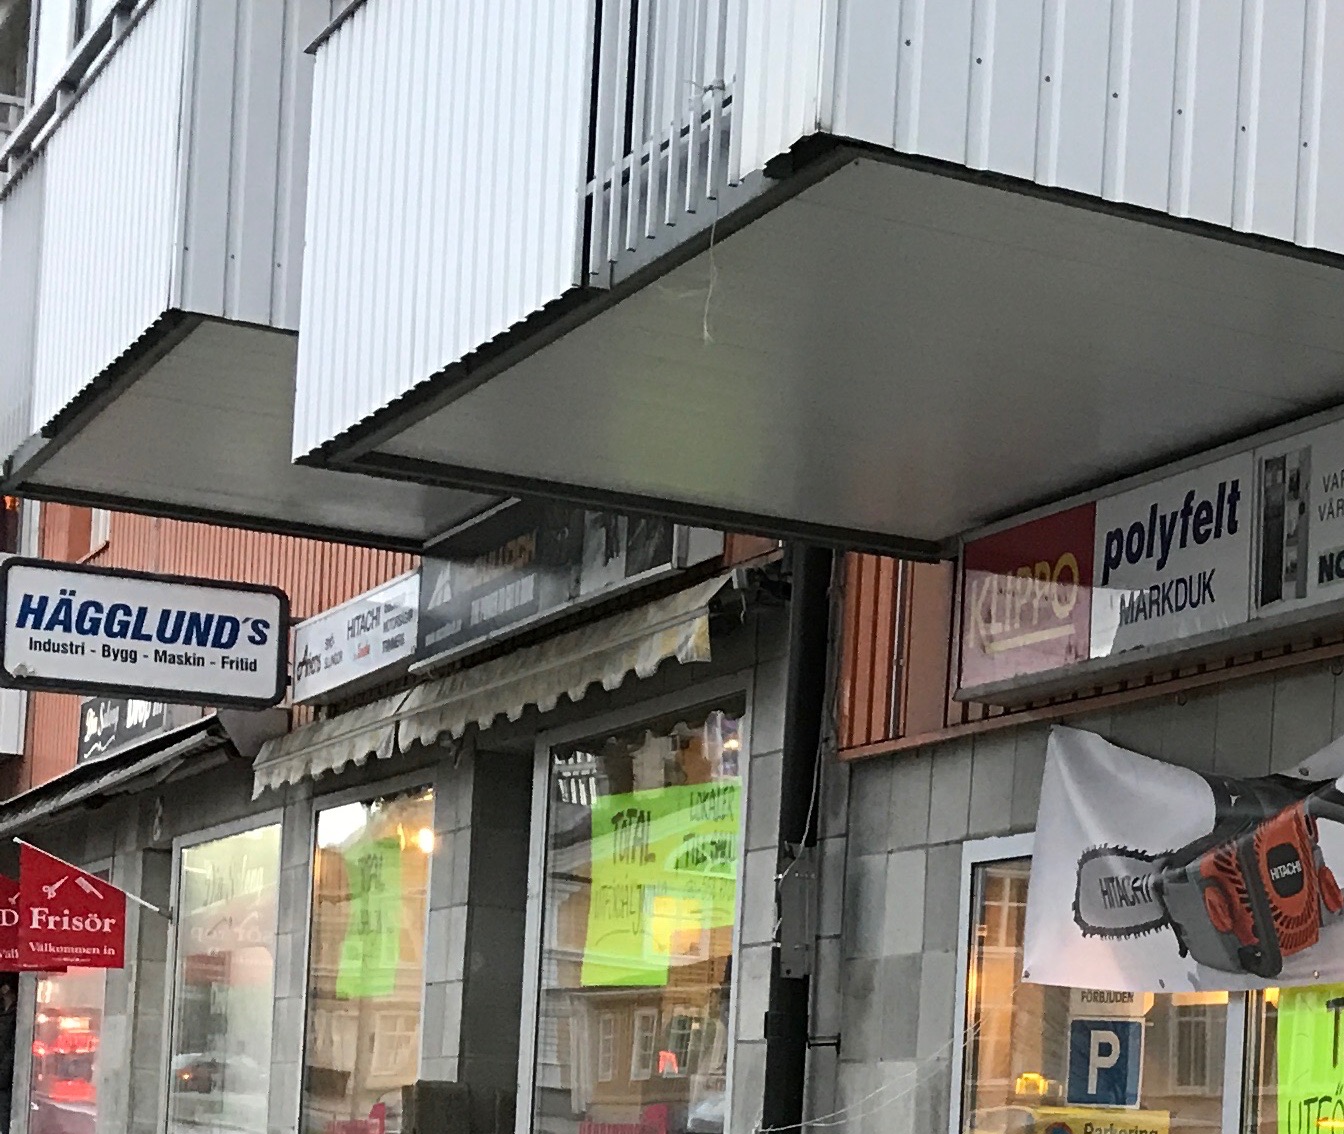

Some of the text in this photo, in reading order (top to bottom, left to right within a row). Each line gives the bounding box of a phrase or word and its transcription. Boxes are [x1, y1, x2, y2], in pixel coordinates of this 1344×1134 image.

[1102, 479, 1241, 585] polyfelt
[969, 552, 1080, 652] KLIPPO
[1119, 568, 1216, 627] MARKDUK
[29, 637, 85, 656] Industri
[101, 644, 138, 664] Bygg
[154, 648, 205, 667] Maskin
[221, 656, 258, 672] Fritid
[28, 941, 100, 956] Välkommen
[103, 945, 116, 956] in
[29, 907, 117, 933] Frisör
[1087, 1030, 1121, 1094] P
